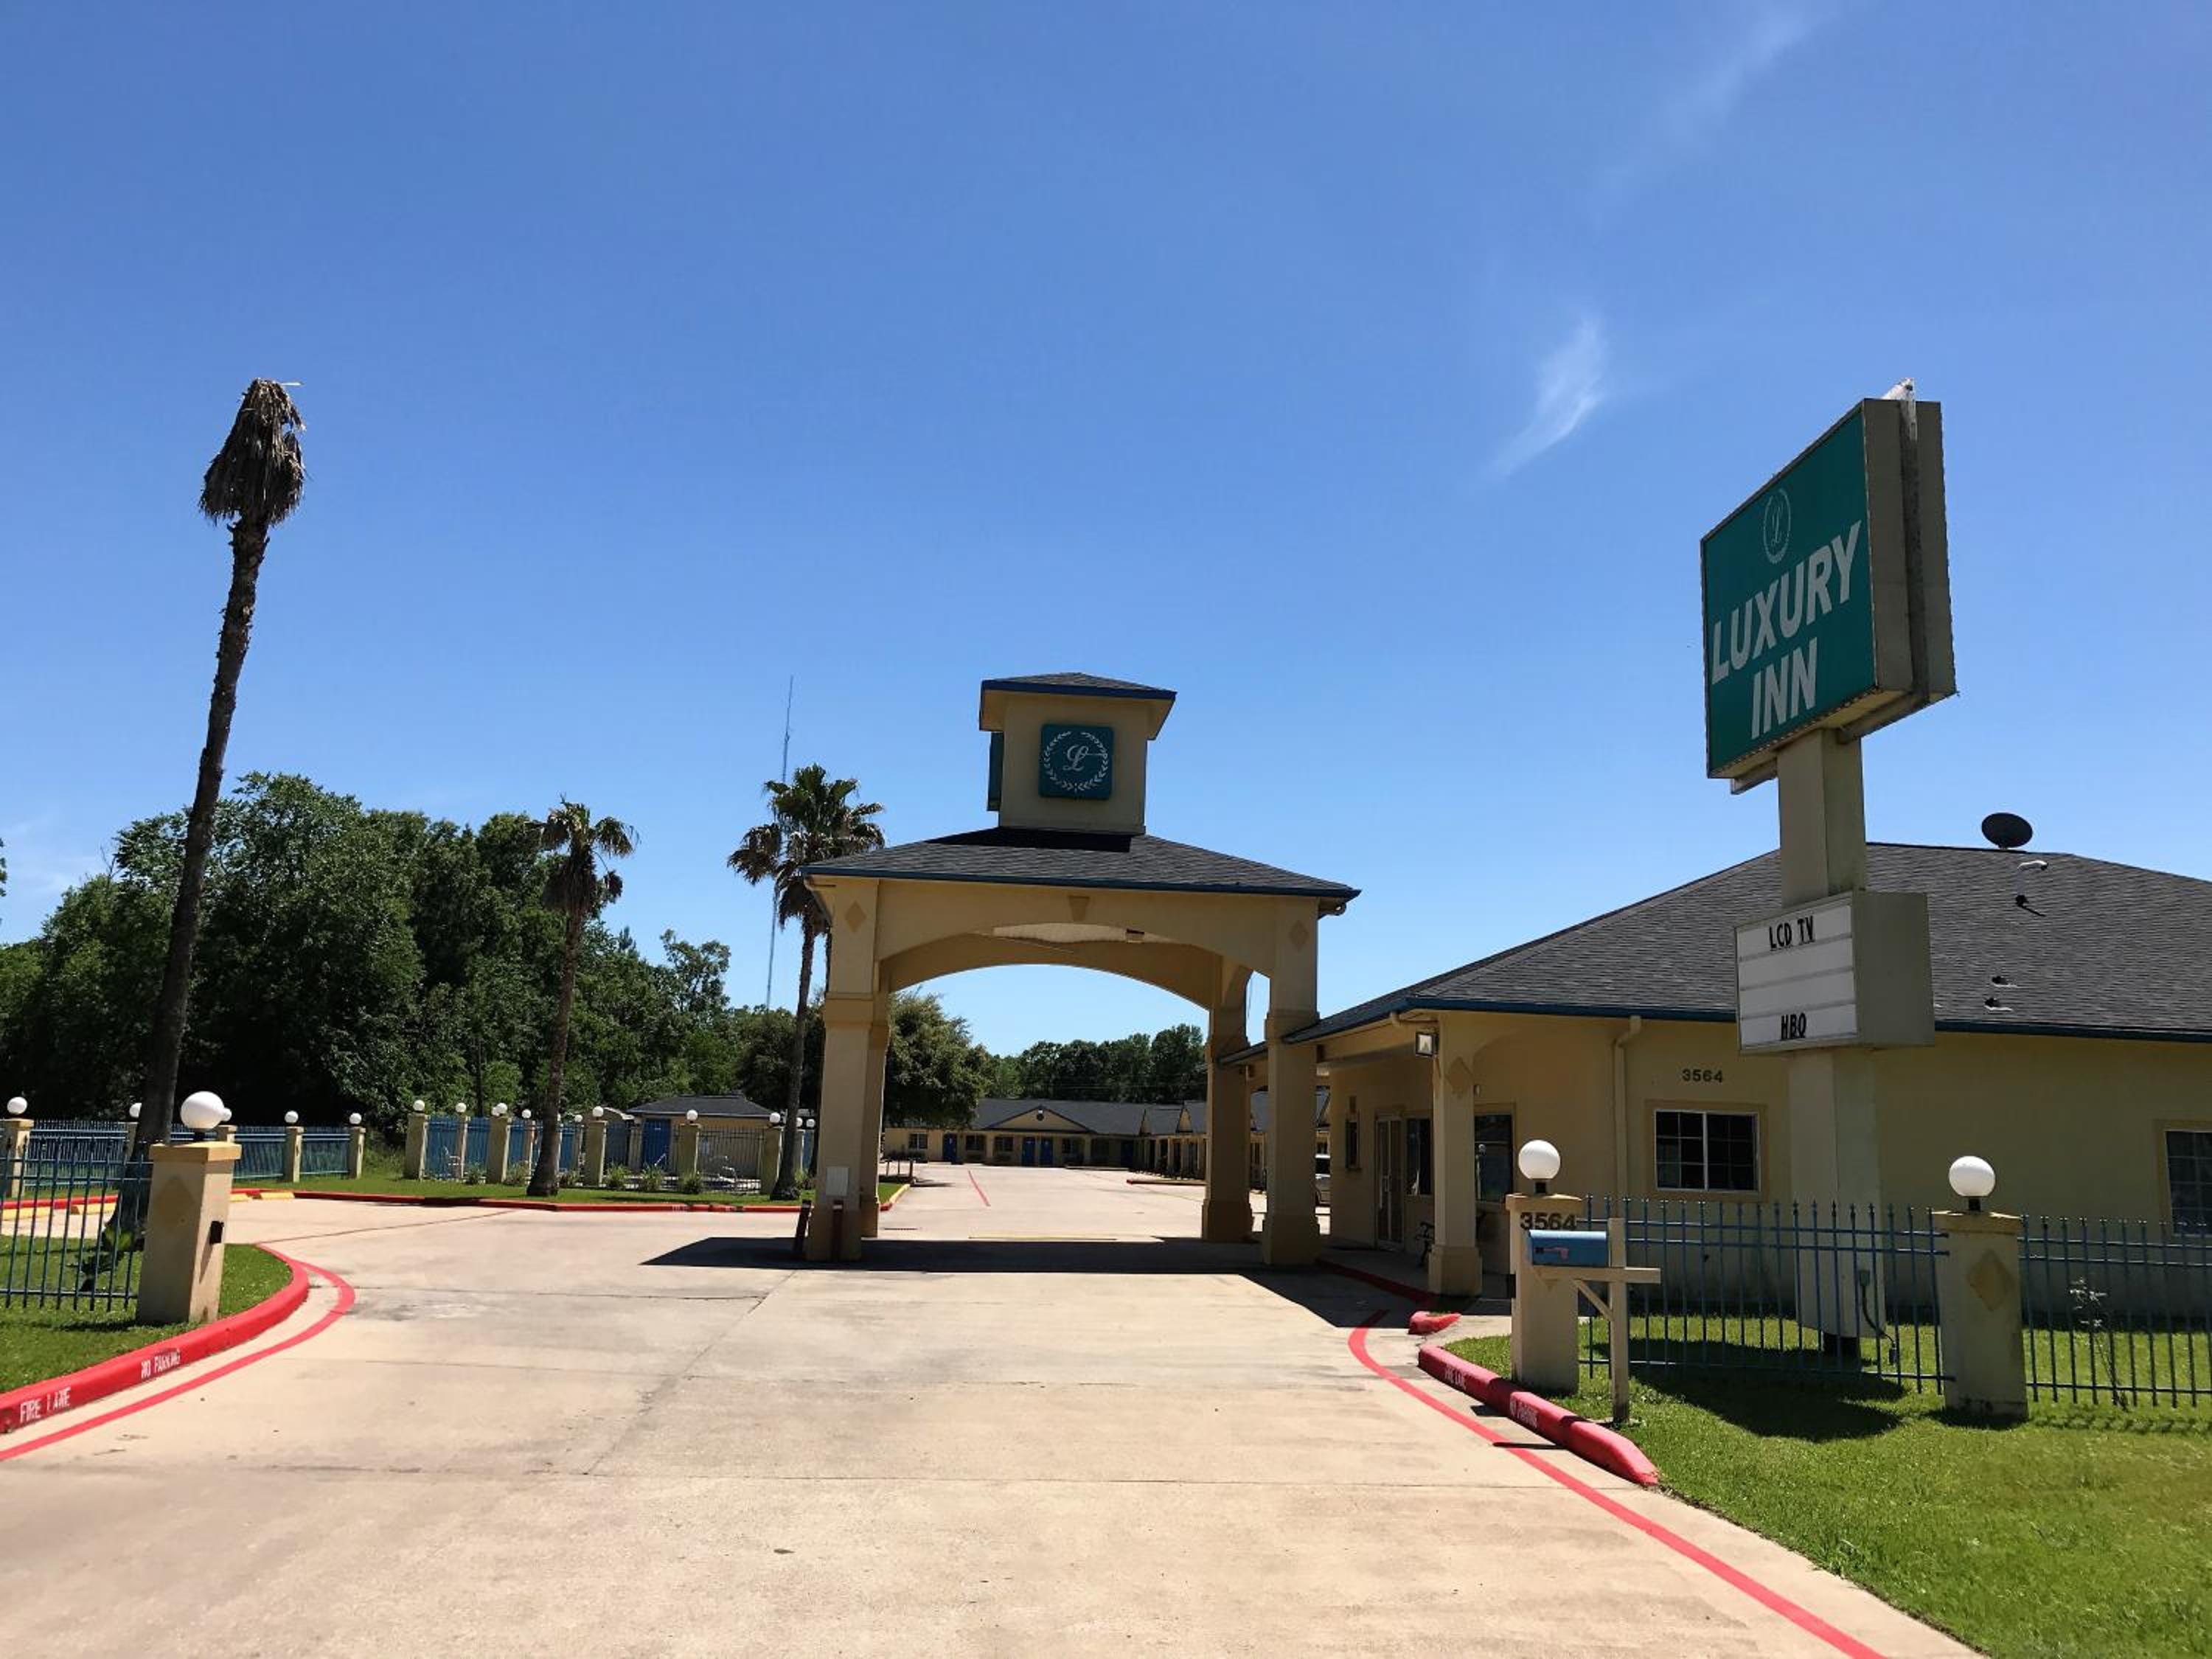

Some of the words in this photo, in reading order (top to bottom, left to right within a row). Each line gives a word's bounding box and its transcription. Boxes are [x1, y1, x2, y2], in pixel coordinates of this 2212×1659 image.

[1711, 519, 1862, 685] LUXURY
[1751, 637, 1818, 740] INN
[1769, 922, 1792, 948] LCD
[1798, 915, 1814, 942] TV
[1682, 1068, 1722, 1083] 3564
[1520, 1212, 1576, 1231] 3564
[19, 1397, 42, 1424] FIRE
